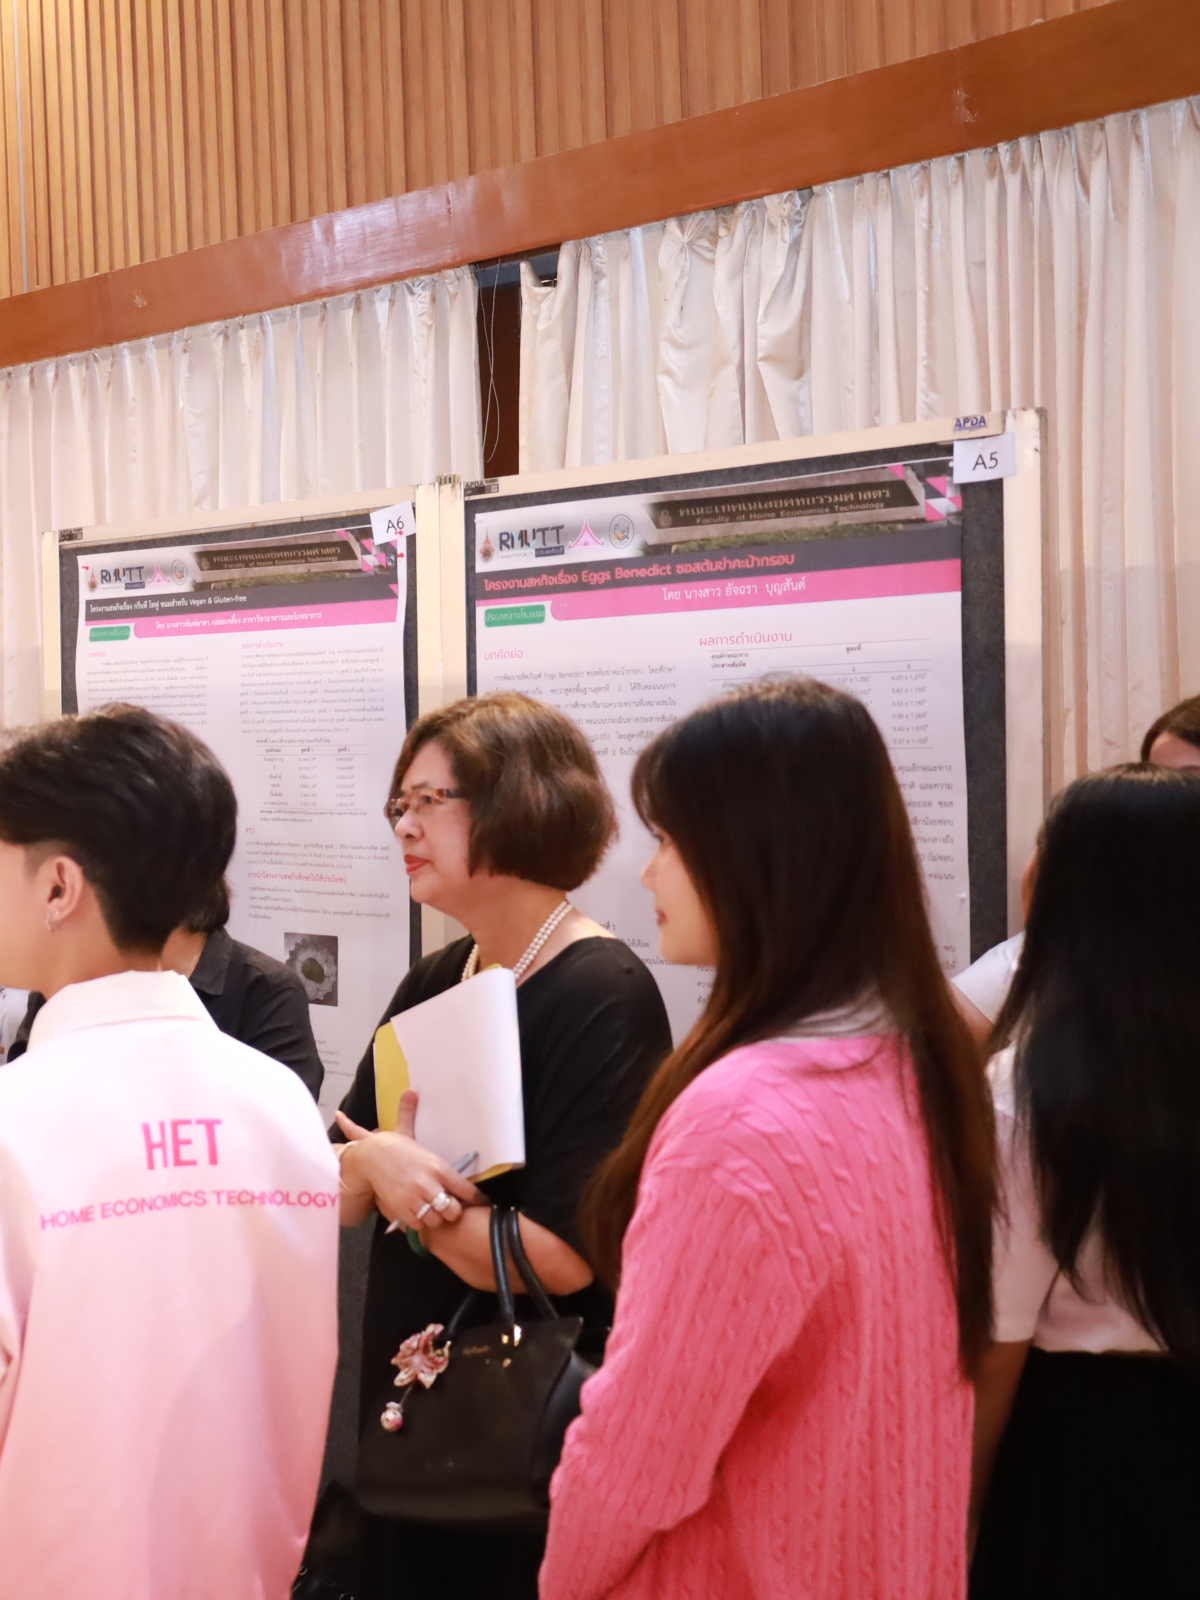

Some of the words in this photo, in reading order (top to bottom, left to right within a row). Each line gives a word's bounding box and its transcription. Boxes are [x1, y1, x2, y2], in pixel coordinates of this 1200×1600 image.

[972, 451, 998, 471] A5
[386, 516, 404, 533] A6
[499, 525, 564, 551] RMUTT
[101, 566, 144, 584] RMUTT
[581, 570, 611, 585] Eggs
[615, 564, 672, 579] Benedict
[189, 598, 206, 607] Vegan
[214, 595, 247, 604] Gluten-free
[663, 587, 681, 601] โดย
[685, 587, 721, 600] นางสาว
[699, 631, 793, 647] ผลการดำเนินงาน
[484, 648, 524, 661] บทคัดย่อ
[141, 1118, 222, 1170] HET
[40, 1205, 96, 1230] HOME
[100, 1190, 207, 1220] ECONOMICS
[211, 1190, 338, 1209] TECHNOLOGY
